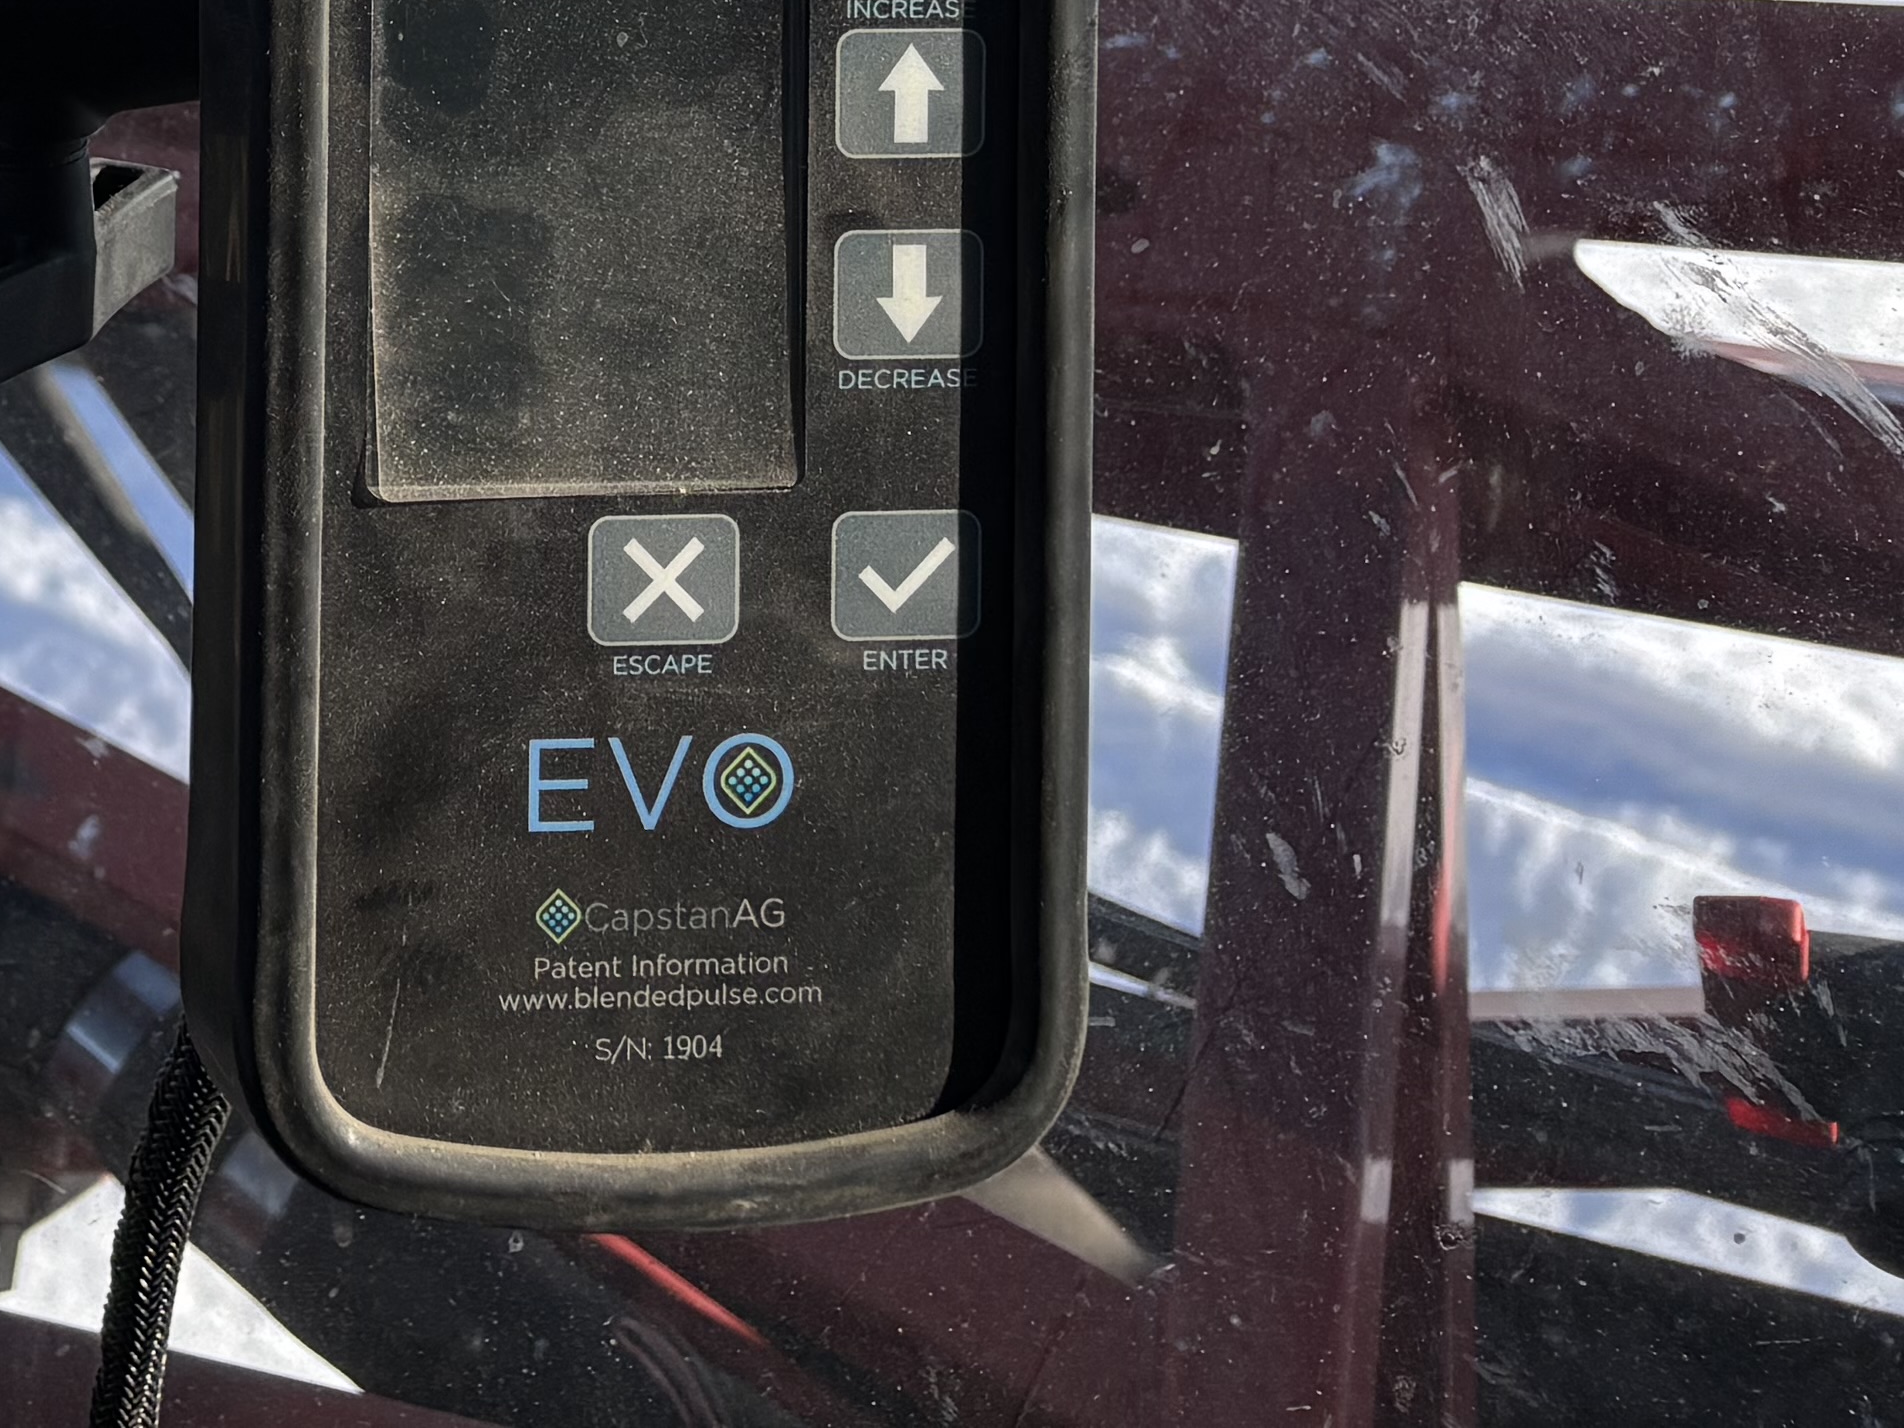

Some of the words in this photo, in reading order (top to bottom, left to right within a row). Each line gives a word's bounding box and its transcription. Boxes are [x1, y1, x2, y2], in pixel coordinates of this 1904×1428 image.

[838, 367, 977, 390] DECREASE
[612, 654, 713, 676] ESCAPE
[862, 649, 948, 671] ENTER
[527, 732, 795, 833] EVO
[584, 897, 786, 937] CapstanAG
[533, 955, 622, 981] Patent
[631, 952, 789, 979] Information
[499, 982, 823, 1011] www.blendedpulse.com
[594, 1034, 653, 1065] S/N:
[662, 1034, 723, 1060] 1904
